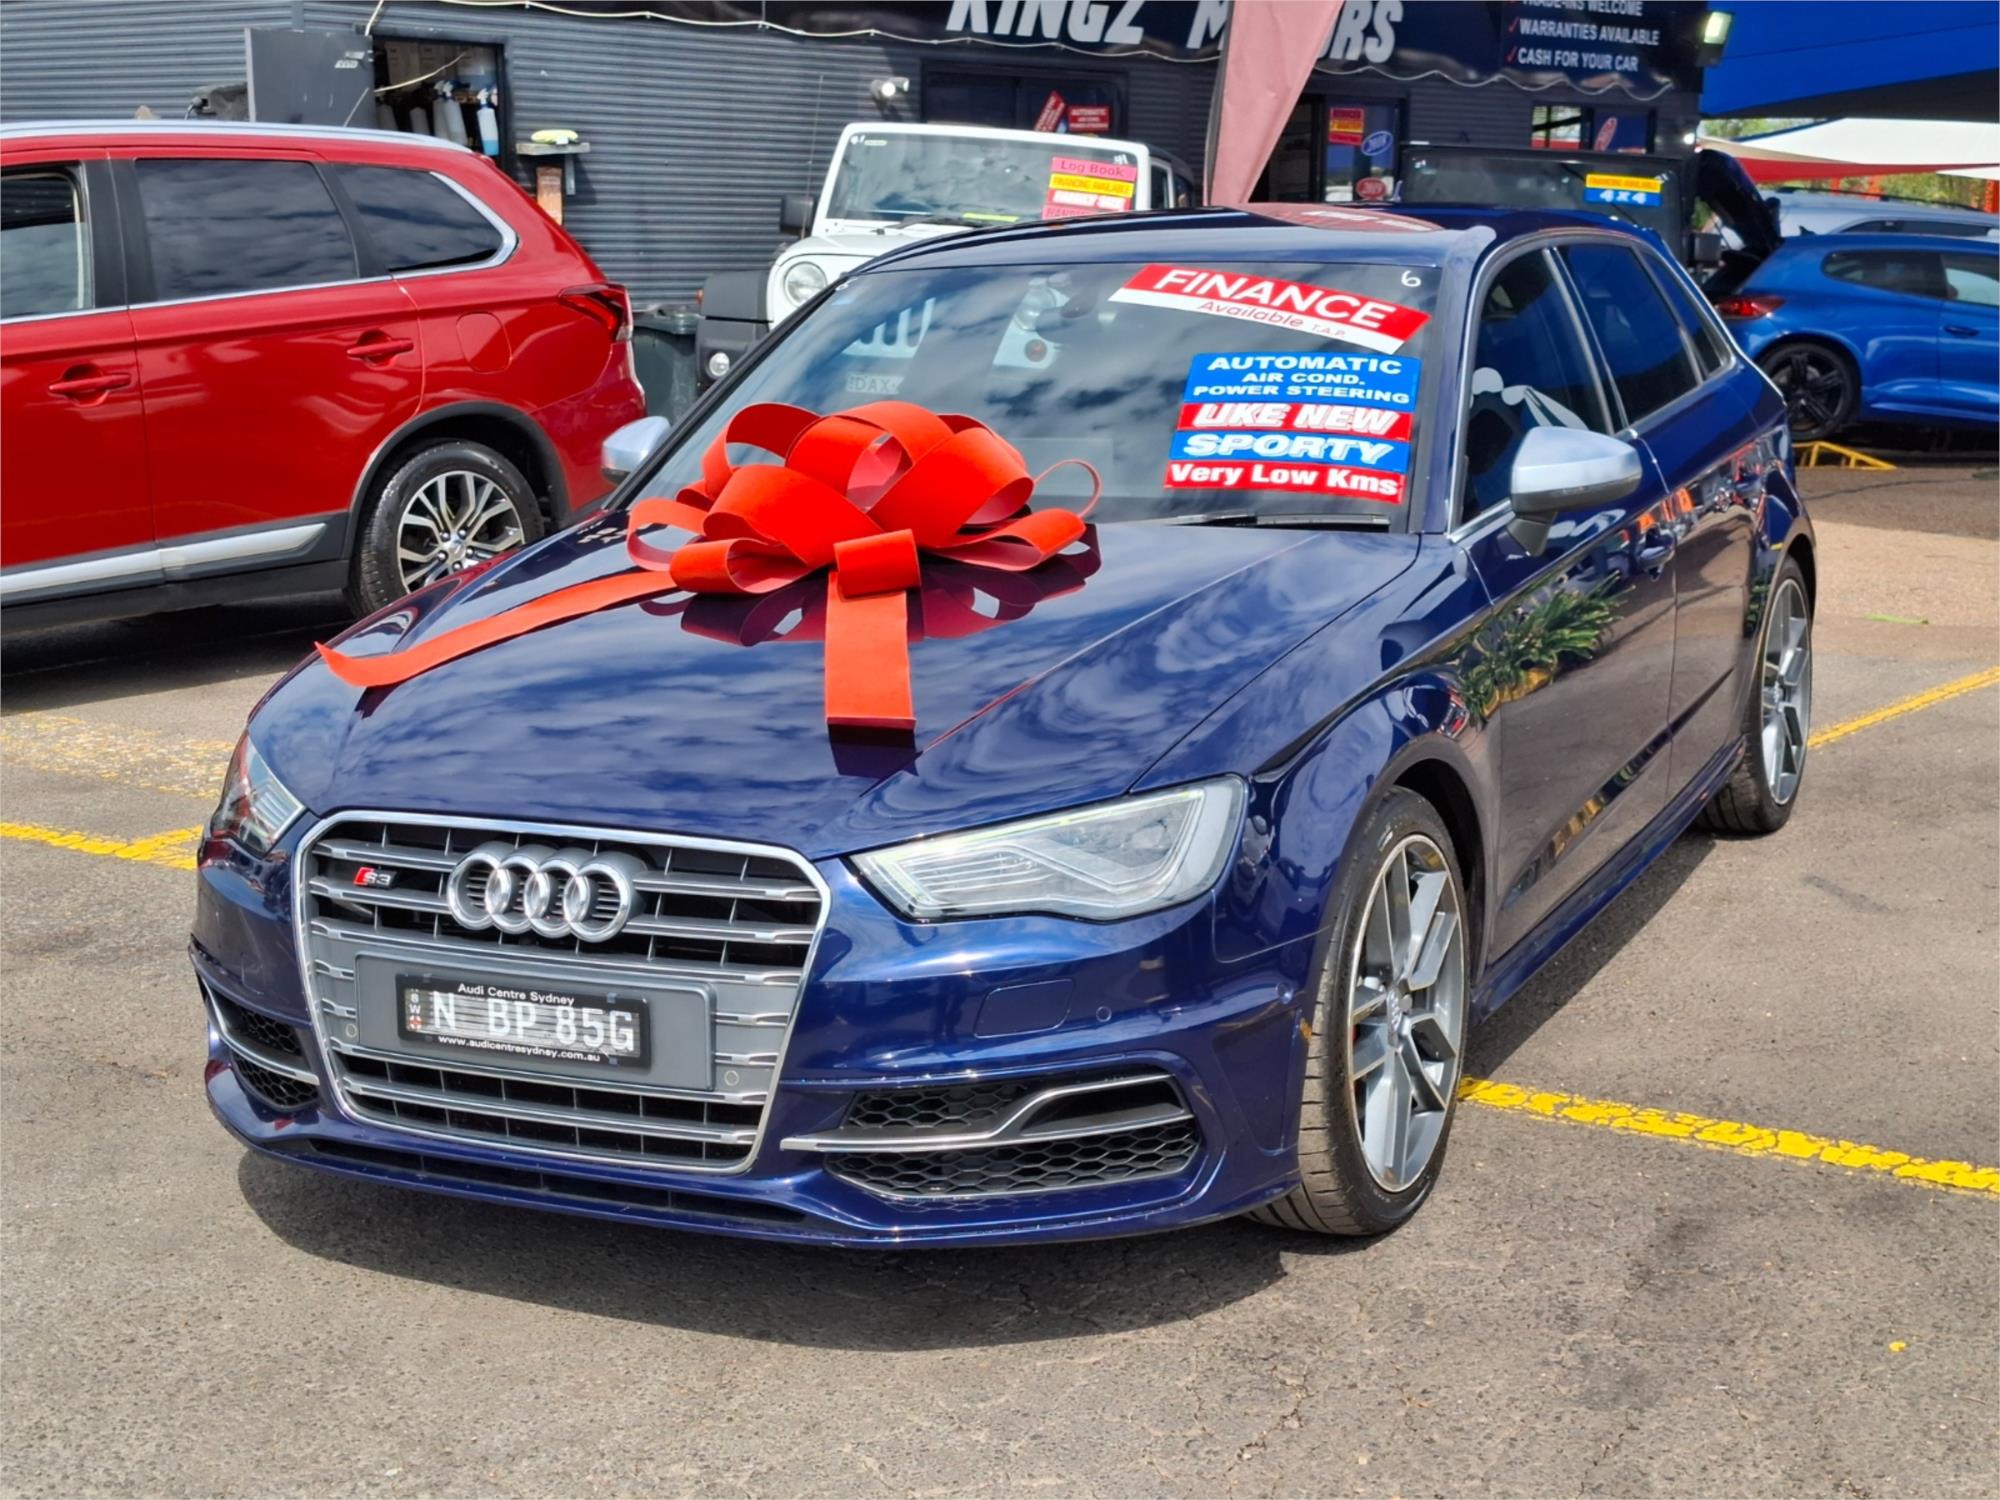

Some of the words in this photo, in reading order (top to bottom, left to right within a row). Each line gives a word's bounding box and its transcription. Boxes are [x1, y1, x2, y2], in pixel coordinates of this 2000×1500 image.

[1588, 0, 1643, 16] WELCOME
[1520, 18, 1597, 40] WARRANTIES
[1600, 25, 1660, 46] AVAILABLE
[1518, 47, 1551, 65] CASH
[1554, 50, 1578, 67] FOR
[1581, 52, 1611, 70] YOUR
[1614, 54, 1639, 72] CAR
[1061, 160, 1085, 174] Log
[1090, 162, 1124, 177] Book
[1401, 270, 1422, 287] 6
[1154, 269, 1396, 328] FINANCE
[1199, 300, 1303, 328] Available
[1207, 356, 1402, 375] AUTOMATIC
[1241, 372, 1284, 383] AIR
[1291, 373, 1365, 385] COND.
[1193, 385, 1279, 396] POWER
[1287, 386, 1410, 404] STEERING
[1193, 402, 1291, 428] LIKE
[1295, 403, 1400, 435] NEW
[1184, 433, 1394, 464] SPORTY
[1170, 463, 1243, 486] Very
[1252, 464, 1318, 484] Low
[1327, 467, 1398, 496] Kms
[364, 871, 391, 886] S3
[458, 983, 484, 995] Audi
[487, 987, 526, 1000] Centre
[530, 991, 575, 1006] Sydney
[487, 998, 536, 1039] BP
[555, 1006, 635, 1052] 85G
[438, 1035, 601, 1062] www.audicentresydney.com.au
